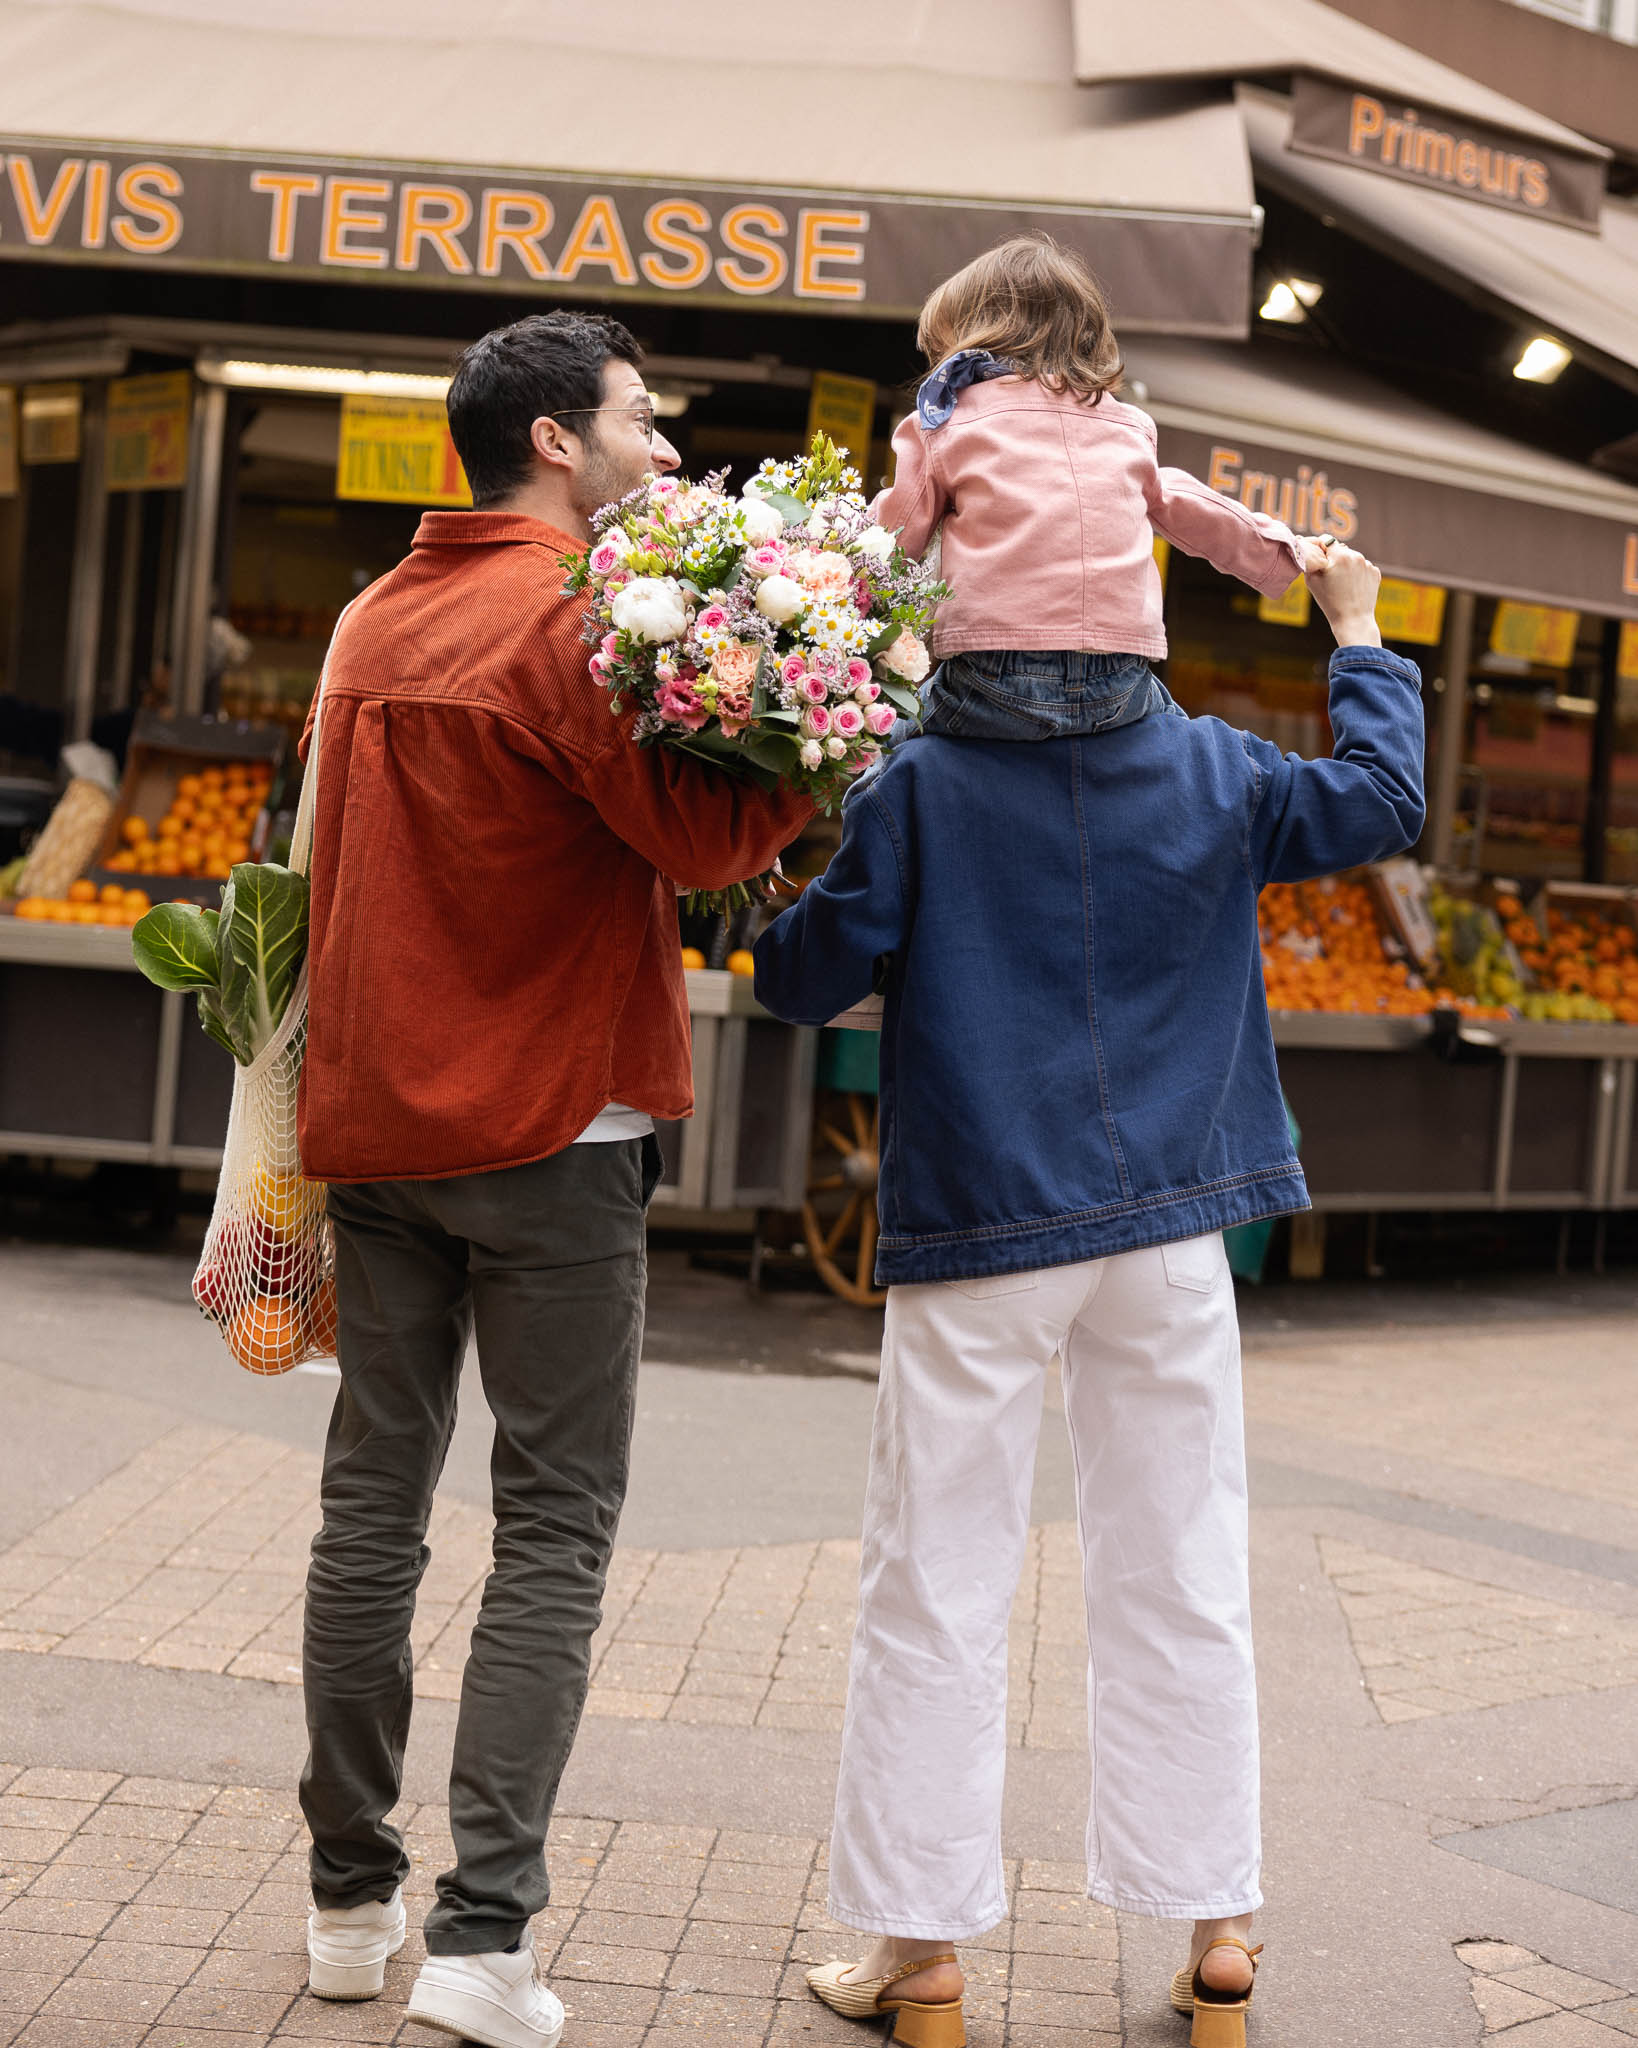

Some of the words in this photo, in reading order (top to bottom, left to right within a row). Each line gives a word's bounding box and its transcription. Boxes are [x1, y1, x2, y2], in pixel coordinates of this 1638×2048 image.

[1350, 93, 1549, 207] Primeurs
[0, 154, 184, 254] VIS
[250, 169, 870, 302] TERRASSE
[1207, 446, 1358, 541] Fruits
